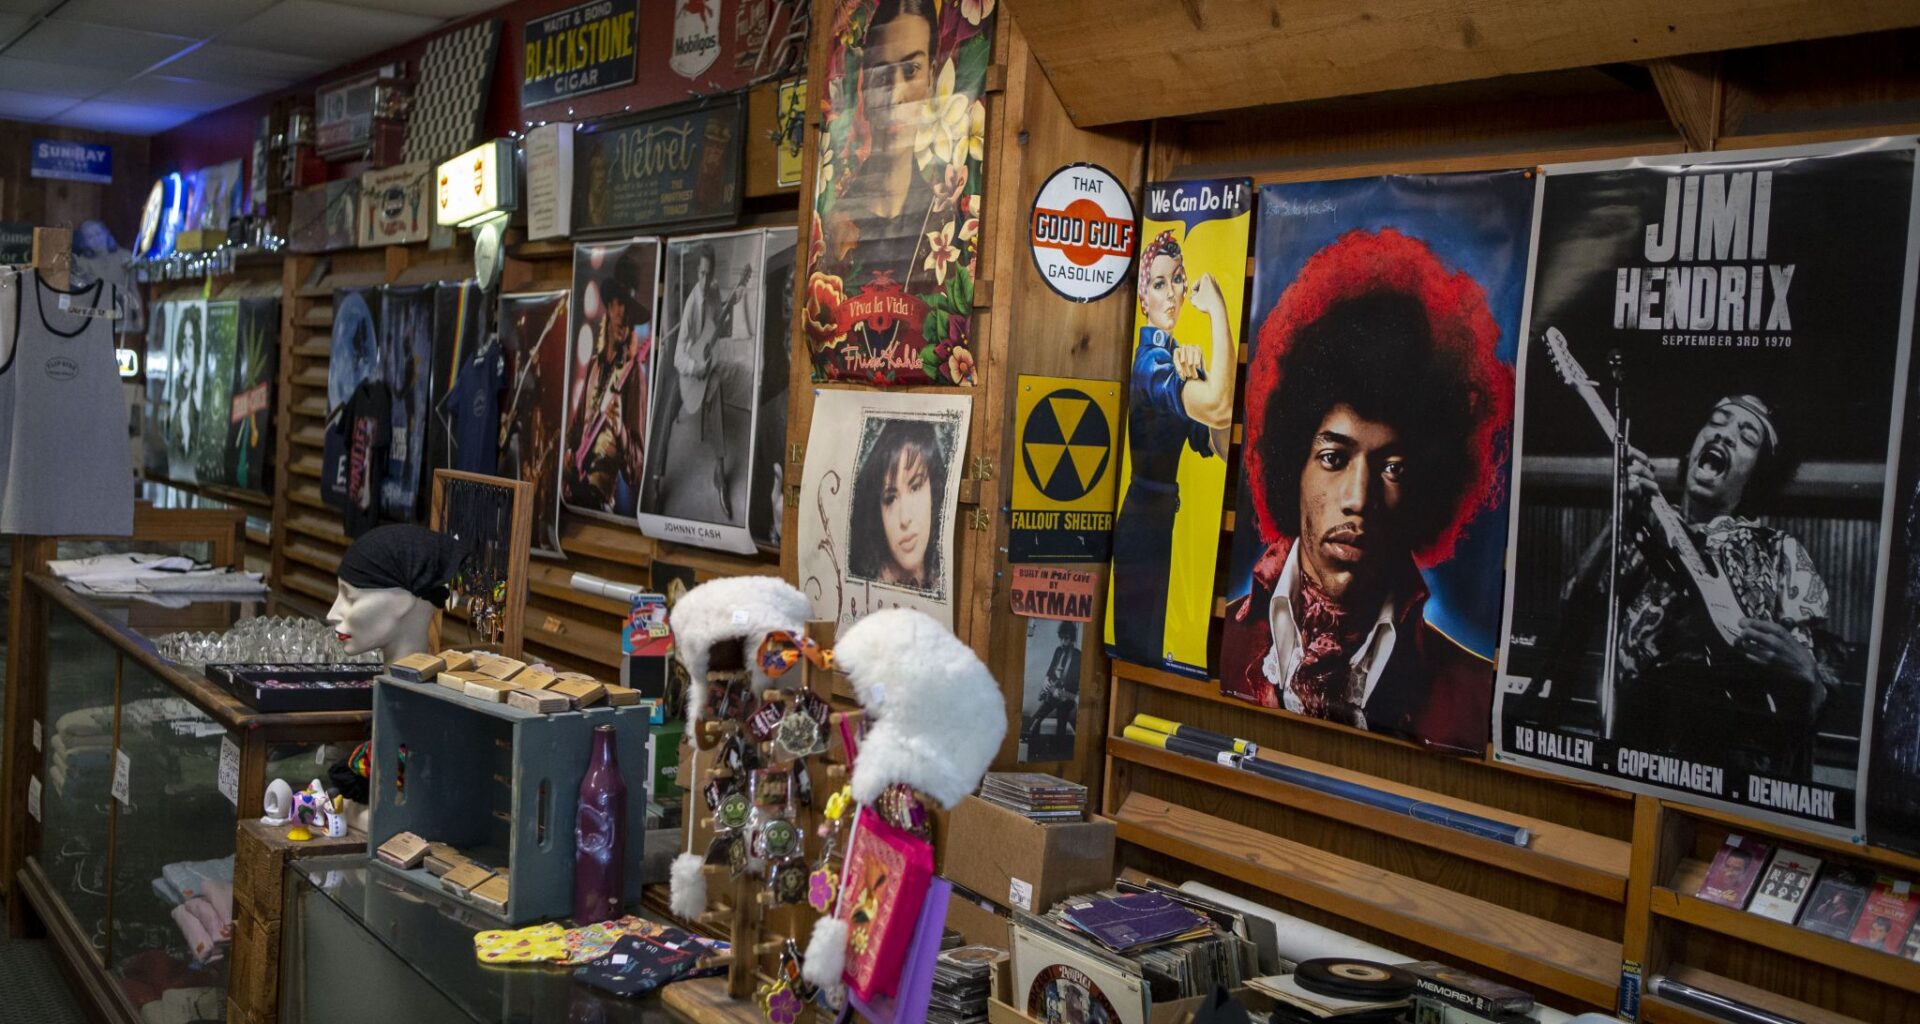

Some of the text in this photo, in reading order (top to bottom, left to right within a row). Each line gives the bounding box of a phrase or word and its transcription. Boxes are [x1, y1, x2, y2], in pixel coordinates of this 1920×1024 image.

[543, 2, 613, 33] WAITT & BOND
[525, 11, 635, 84] BLACKSTONE
[675, 33, 716, 56] Mobilgas
[554, 69, 598, 93] CIGAR
[608, 120, 696, 182] Velvet
[1072, 177, 1103, 193] THAT
[1151, 184, 1241, 213] We Can Do It!
[1645, 171, 1773, 262] JIMI
[1036, 213, 1133, 252] GOOD GULF
[1048, 264, 1114, 284] GASOLINE
[850, 301, 872, 318] Viva
[874, 297, 884, 314] la
[1613, 264, 1796, 331] HENDRIX
[1662, 335, 1792, 347] SEPTEMBER 3RD 1970
[841, 343, 886, 372] Frida
[664, 522, 696, 535] JOHNNY
[698, 527, 721, 540] CASH
[1011, 512, 1112, 531] FALLOUT SHELTER
[1019, 569, 1039, 579] BUILT
[1040, 570, 1049, 579] IN
[1072, 574, 1090, 584] CAVE
[1049, 581, 1058, 590] BY
[1011, 589, 1093, 618] BATMAN
[1515, 725, 1535, 753] KB
[1537, 733, 1593, 766] HALLEN
[1617, 747, 1723, 795] COPENHAGEN
[1748, 774, 1834, 820] DENMARK
[1417, 978, 1475, 1006] MEMOREX
